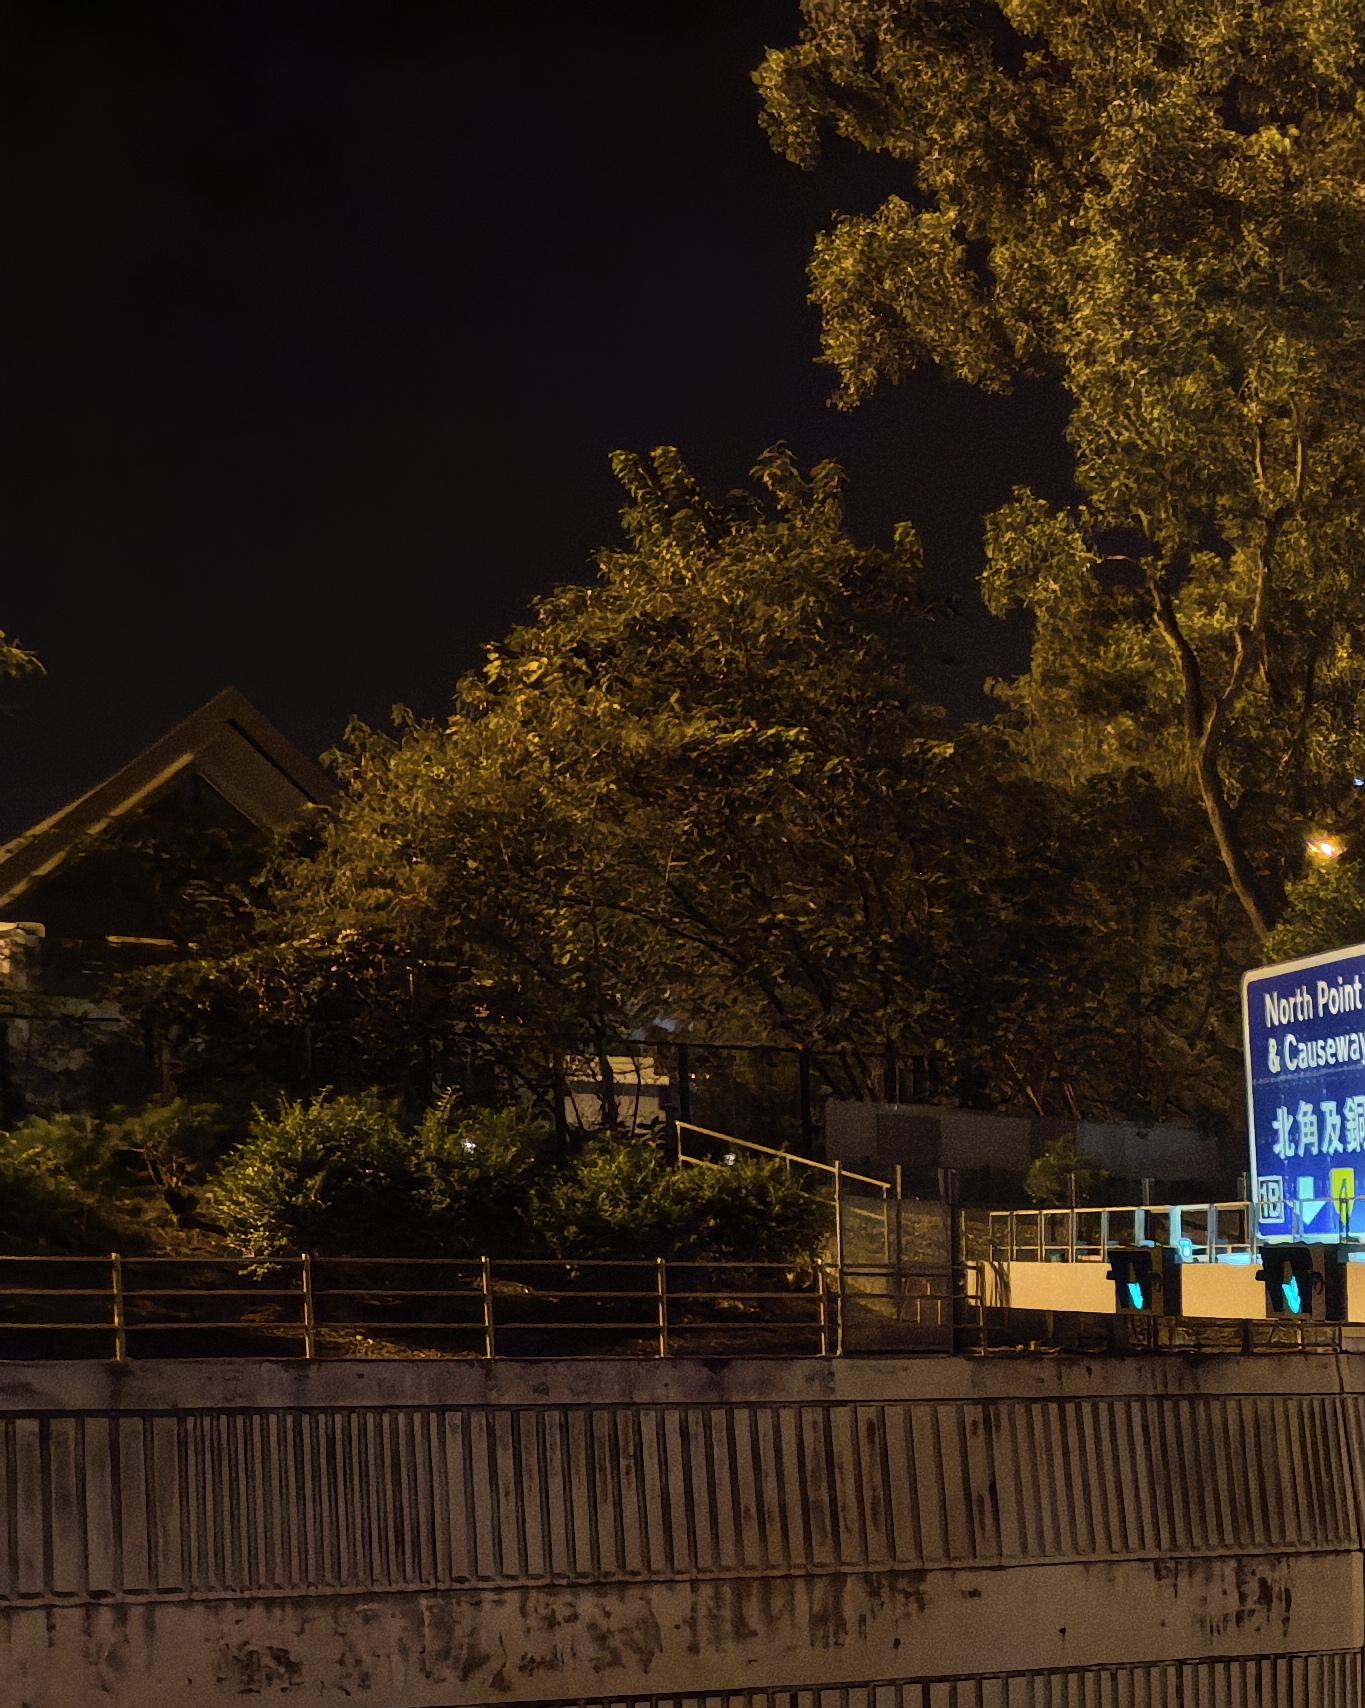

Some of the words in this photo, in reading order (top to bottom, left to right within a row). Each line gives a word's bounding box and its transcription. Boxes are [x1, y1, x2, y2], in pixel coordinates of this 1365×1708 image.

[1264, 985, 1314, 1029] North
[1316, 975, 1363, 1018] Point
[1267, 1037, 1281, 1074] &
